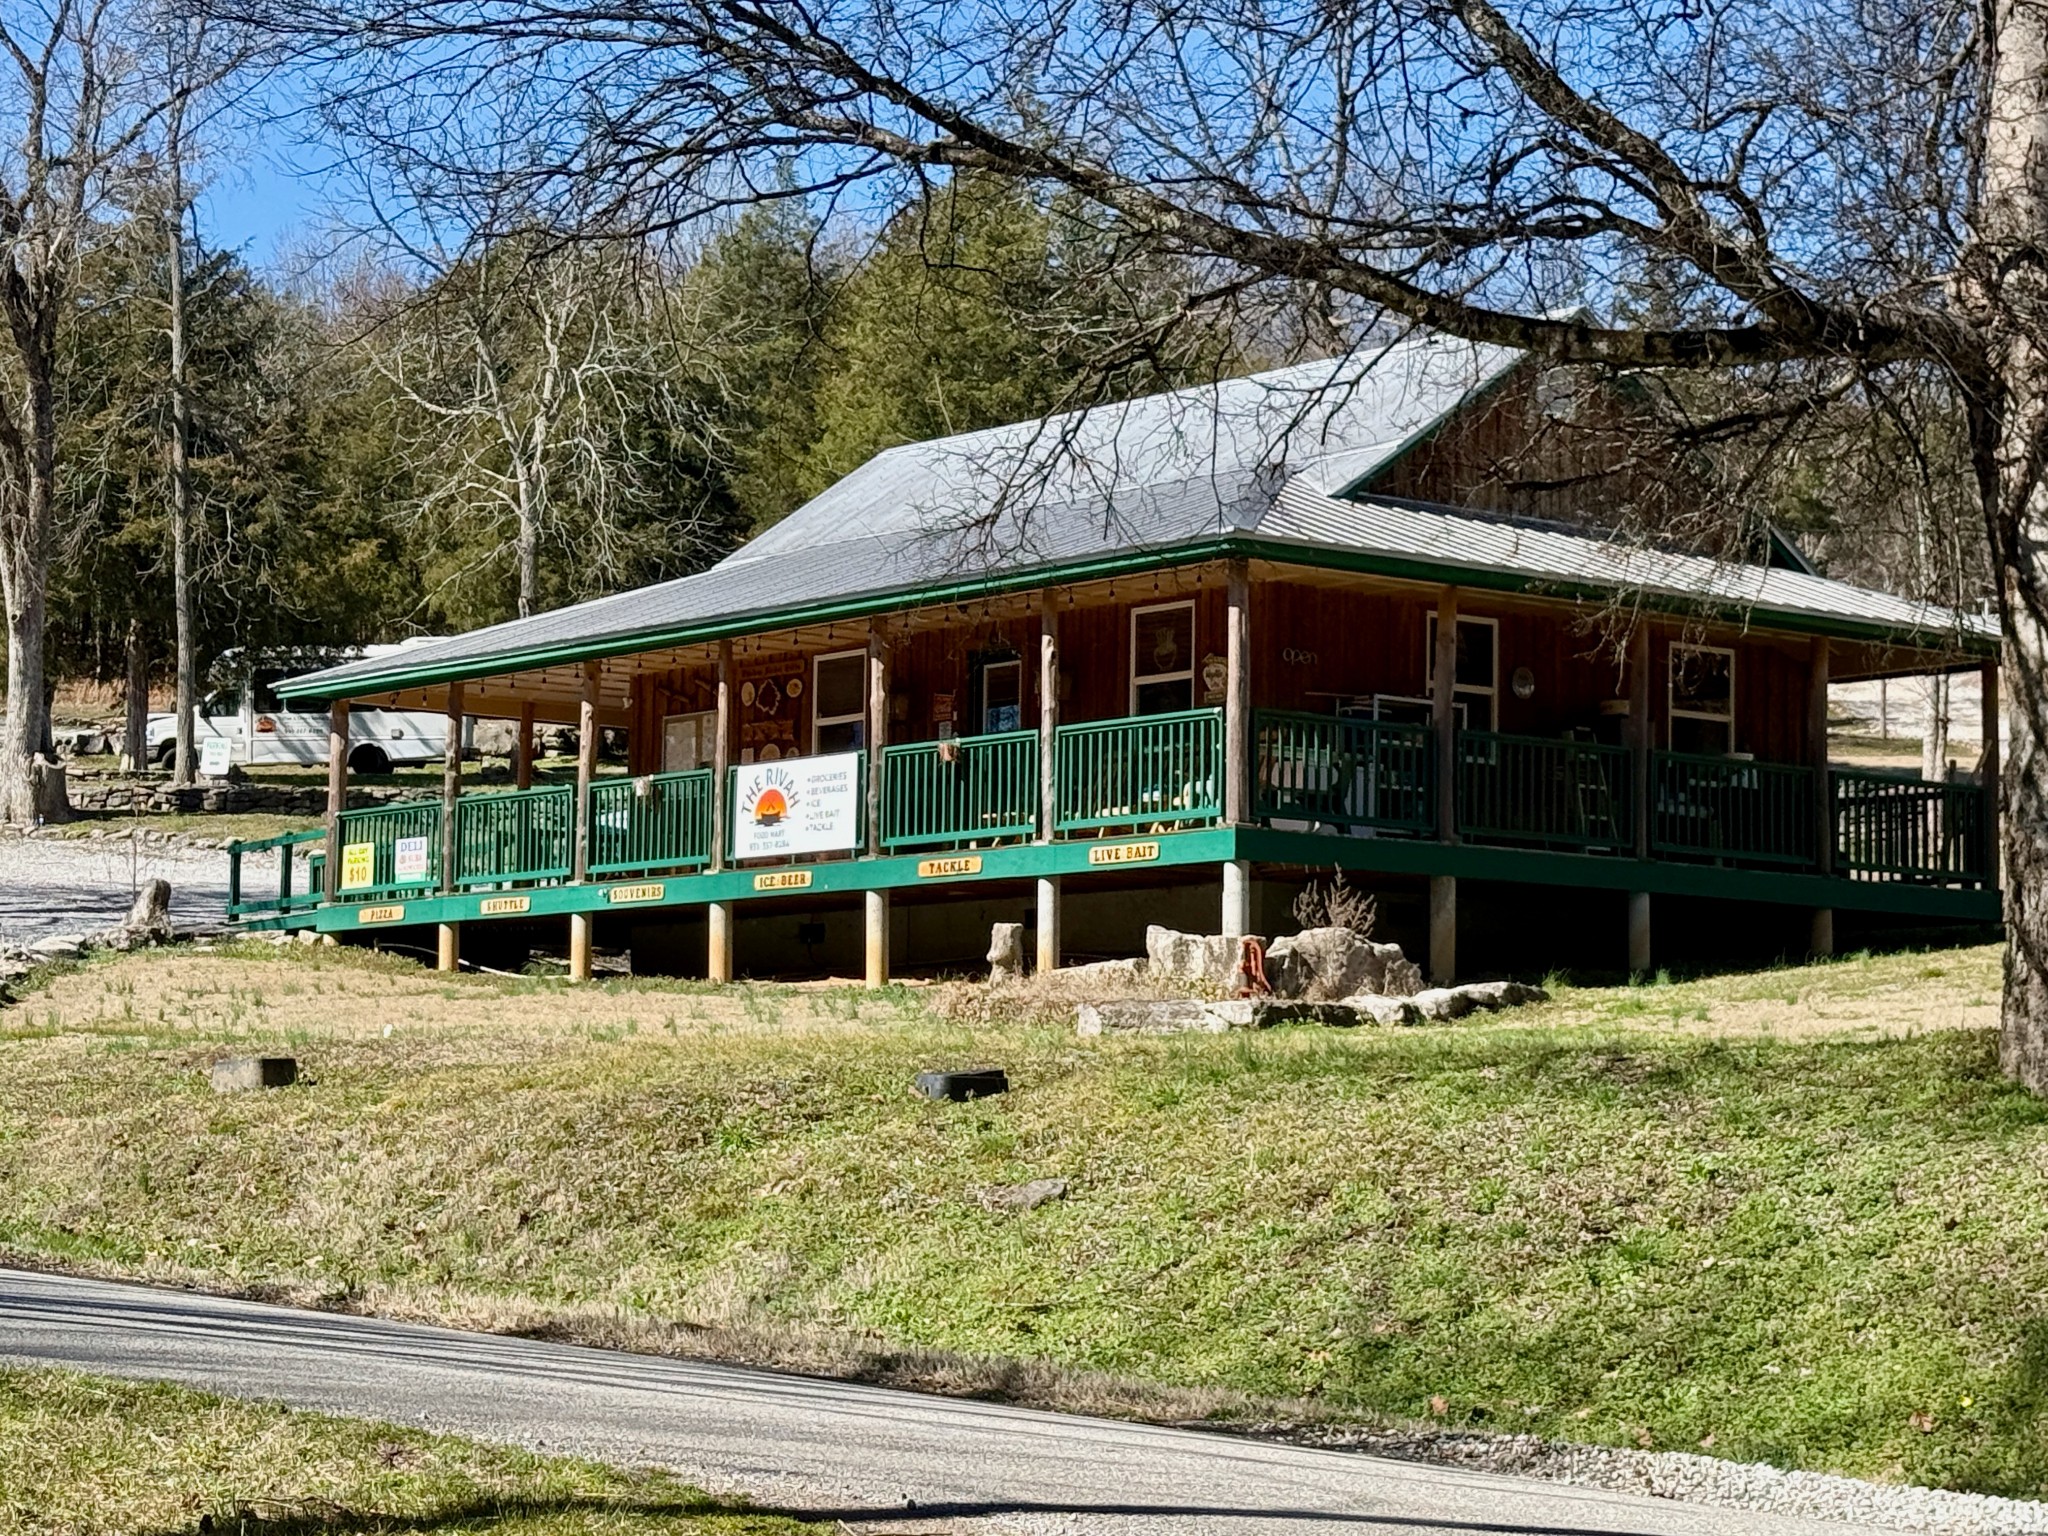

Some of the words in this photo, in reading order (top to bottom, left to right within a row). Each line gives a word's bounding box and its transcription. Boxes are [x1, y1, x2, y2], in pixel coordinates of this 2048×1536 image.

[1283, 648, 1317, 665] open
[811, 771, 847, 784] GROCERIES
[742, 775, 763, 814] THE
[766, 767, 800, 808] RIVAH
[811, 784, 848, 795] BEVERAGES
[811, 799, 821, 807] ICE
[810, 811, 824, 820] LIVE
[825, 809, 840, 819] BAIT
[810, 822, 833, 831] TACKLE
[770, 829, 785, 838] MART
[400, 841, 422, 852] DELI
[1094, 849, 1120, 862] LIVE
[1126, 845, 1154, 859] BAIT
[929, 859, 970, 874] TACKLE
[350, 866, 367, 882] $10
[760, 876, 776, 888] ICE
[781, 874, 806, 886] BEER
[613, 886, 662, 900] SOUVENIRS
[487, 899, 524, 911] SHUTTLE
[371, 908, 393, 919] PIZZA
